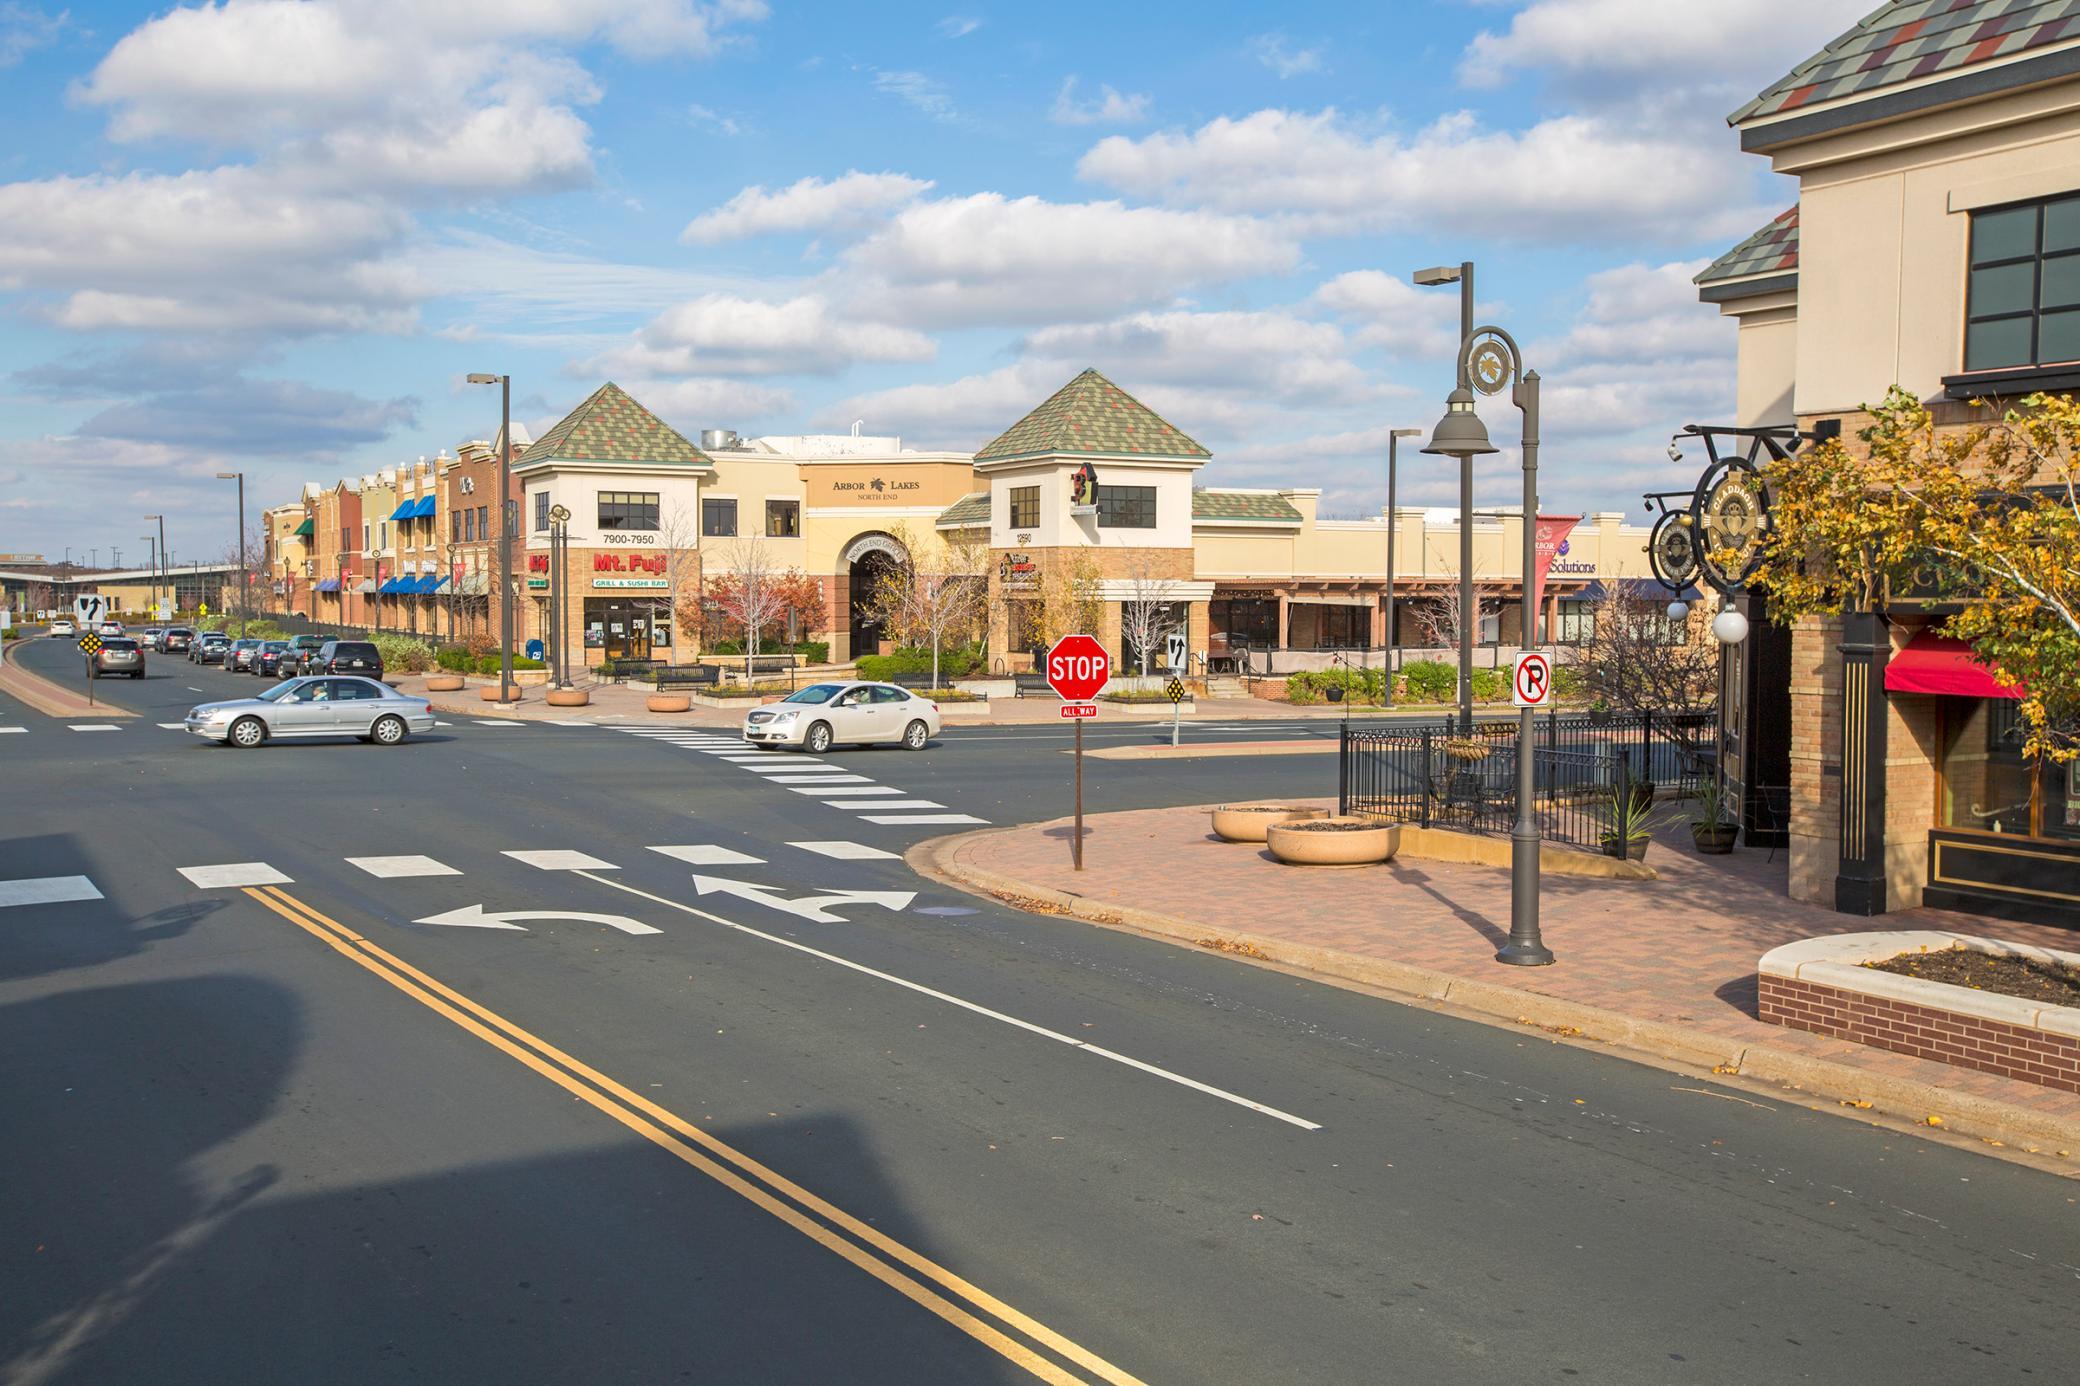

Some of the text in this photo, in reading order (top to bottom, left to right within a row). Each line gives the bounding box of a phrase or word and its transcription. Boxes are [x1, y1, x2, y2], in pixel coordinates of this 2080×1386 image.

[833, 481, 920, 490] ARBOR LAKES
[1713, 485, 1754, 511] CLADDAGH
[603, 534, 655, 545] 7900-7950
[1536, 541, 1556, 550] RBOR
[593, 553, 668, 577] Mt. Fuji
[1548, 558, 1597, 574] Solutions
[1051, 656, 1106, 681] STOP
[1063, 707, 1095, 716] ALL WAY
